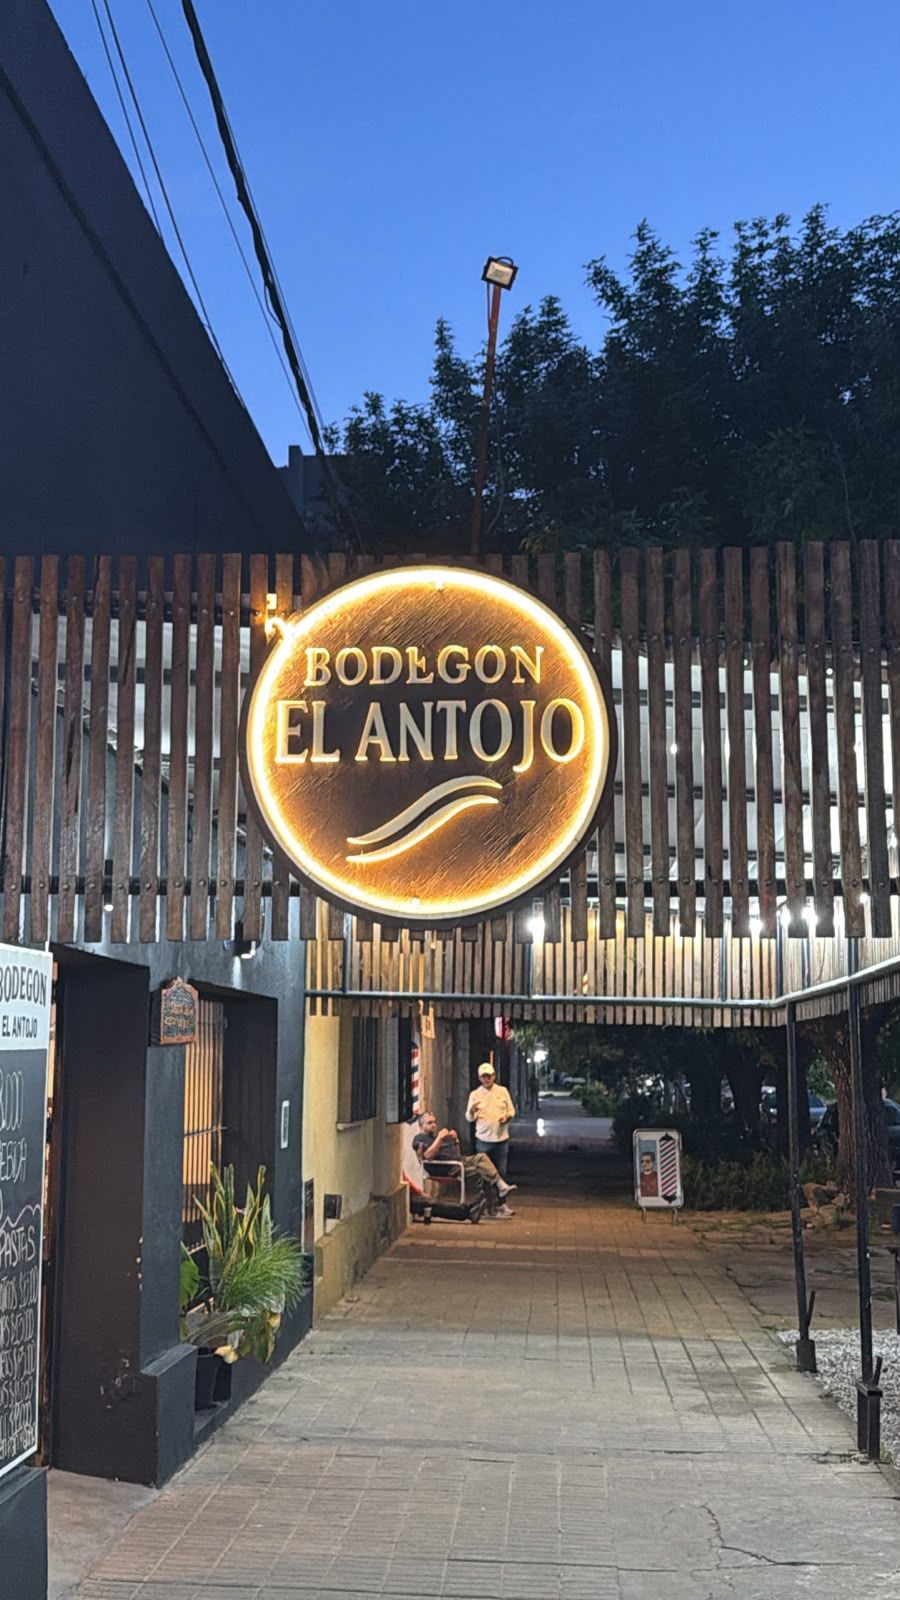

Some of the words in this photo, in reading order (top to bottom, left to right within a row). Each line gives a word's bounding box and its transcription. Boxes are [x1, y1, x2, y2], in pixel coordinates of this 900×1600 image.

[304, 645, 544, 686] BODEGON
[274, 700, 340, 763] EL
[355, 698, 585, 772] ANTOJO
[0, 965, 47, 1007] BODEGON
[2, 1015, 10, 1037] EL
[12, 1015, 38, 1038] ANTOJO
